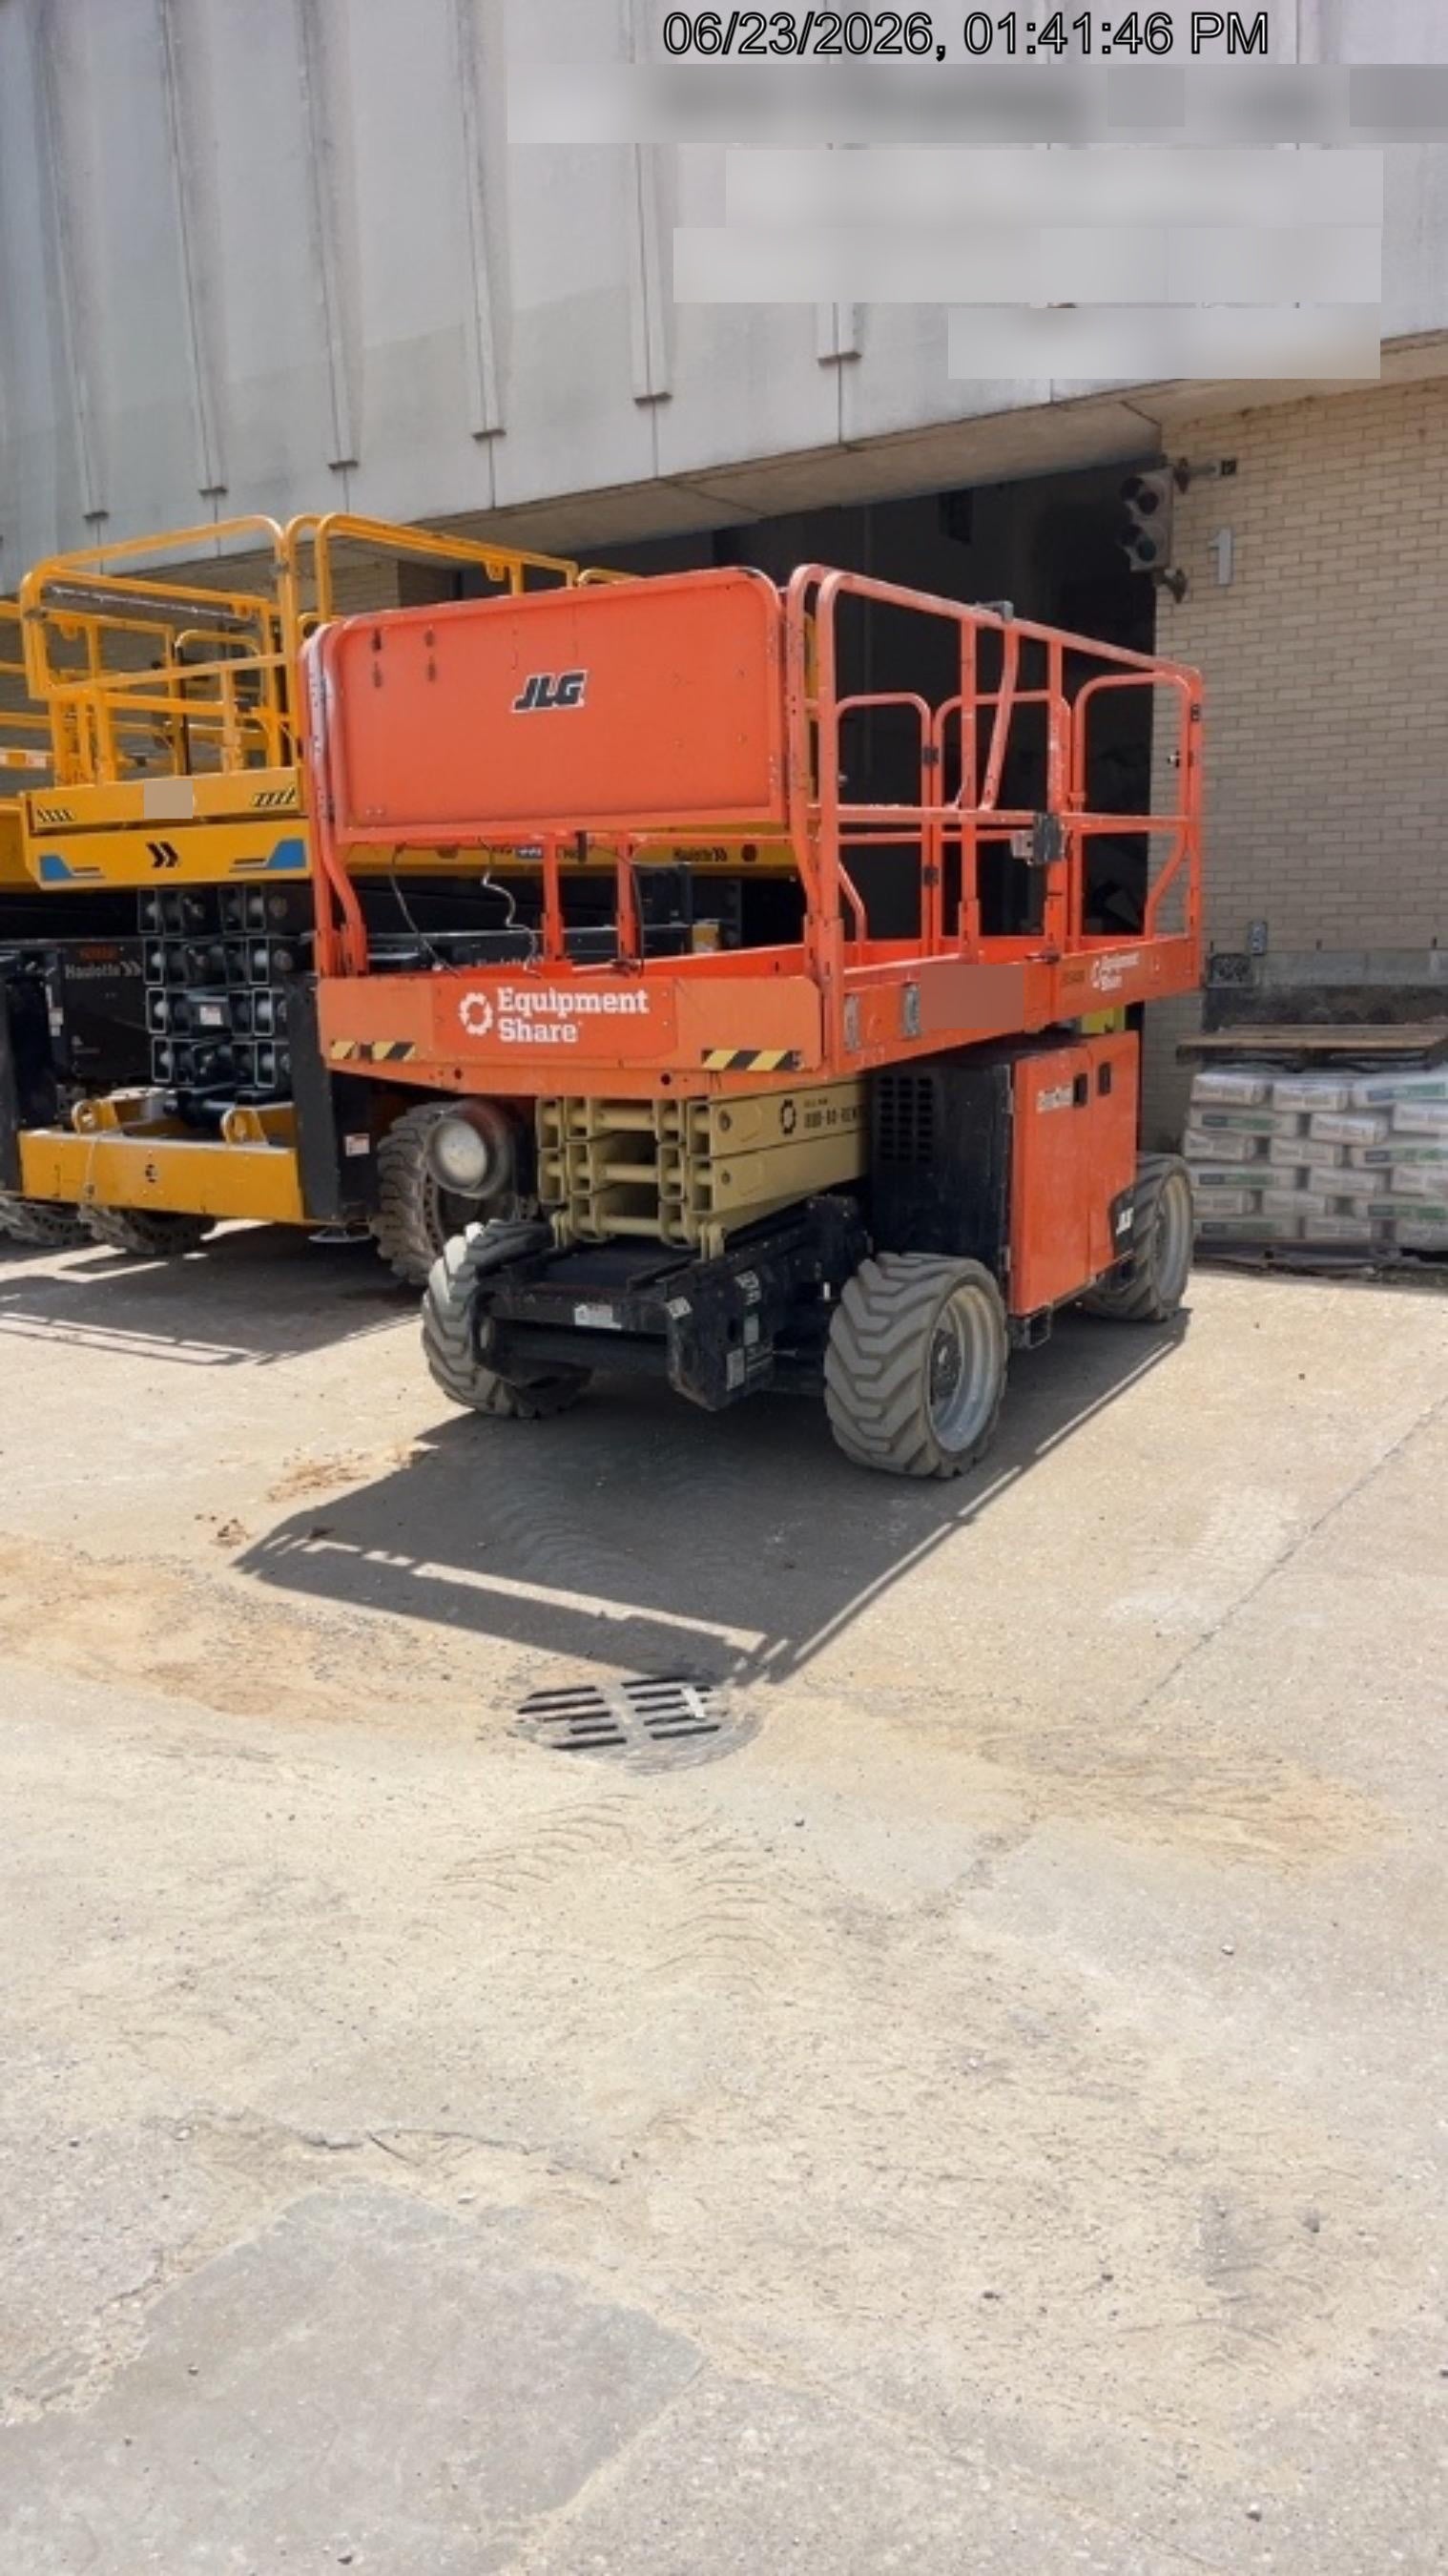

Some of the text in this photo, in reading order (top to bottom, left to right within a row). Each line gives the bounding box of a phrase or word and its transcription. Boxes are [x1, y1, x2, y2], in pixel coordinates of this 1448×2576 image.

[510, 670, 587, 713] JLG
[497, 987, 650, 1018] Equipment
[498, 1018, 579, 1043] Share
